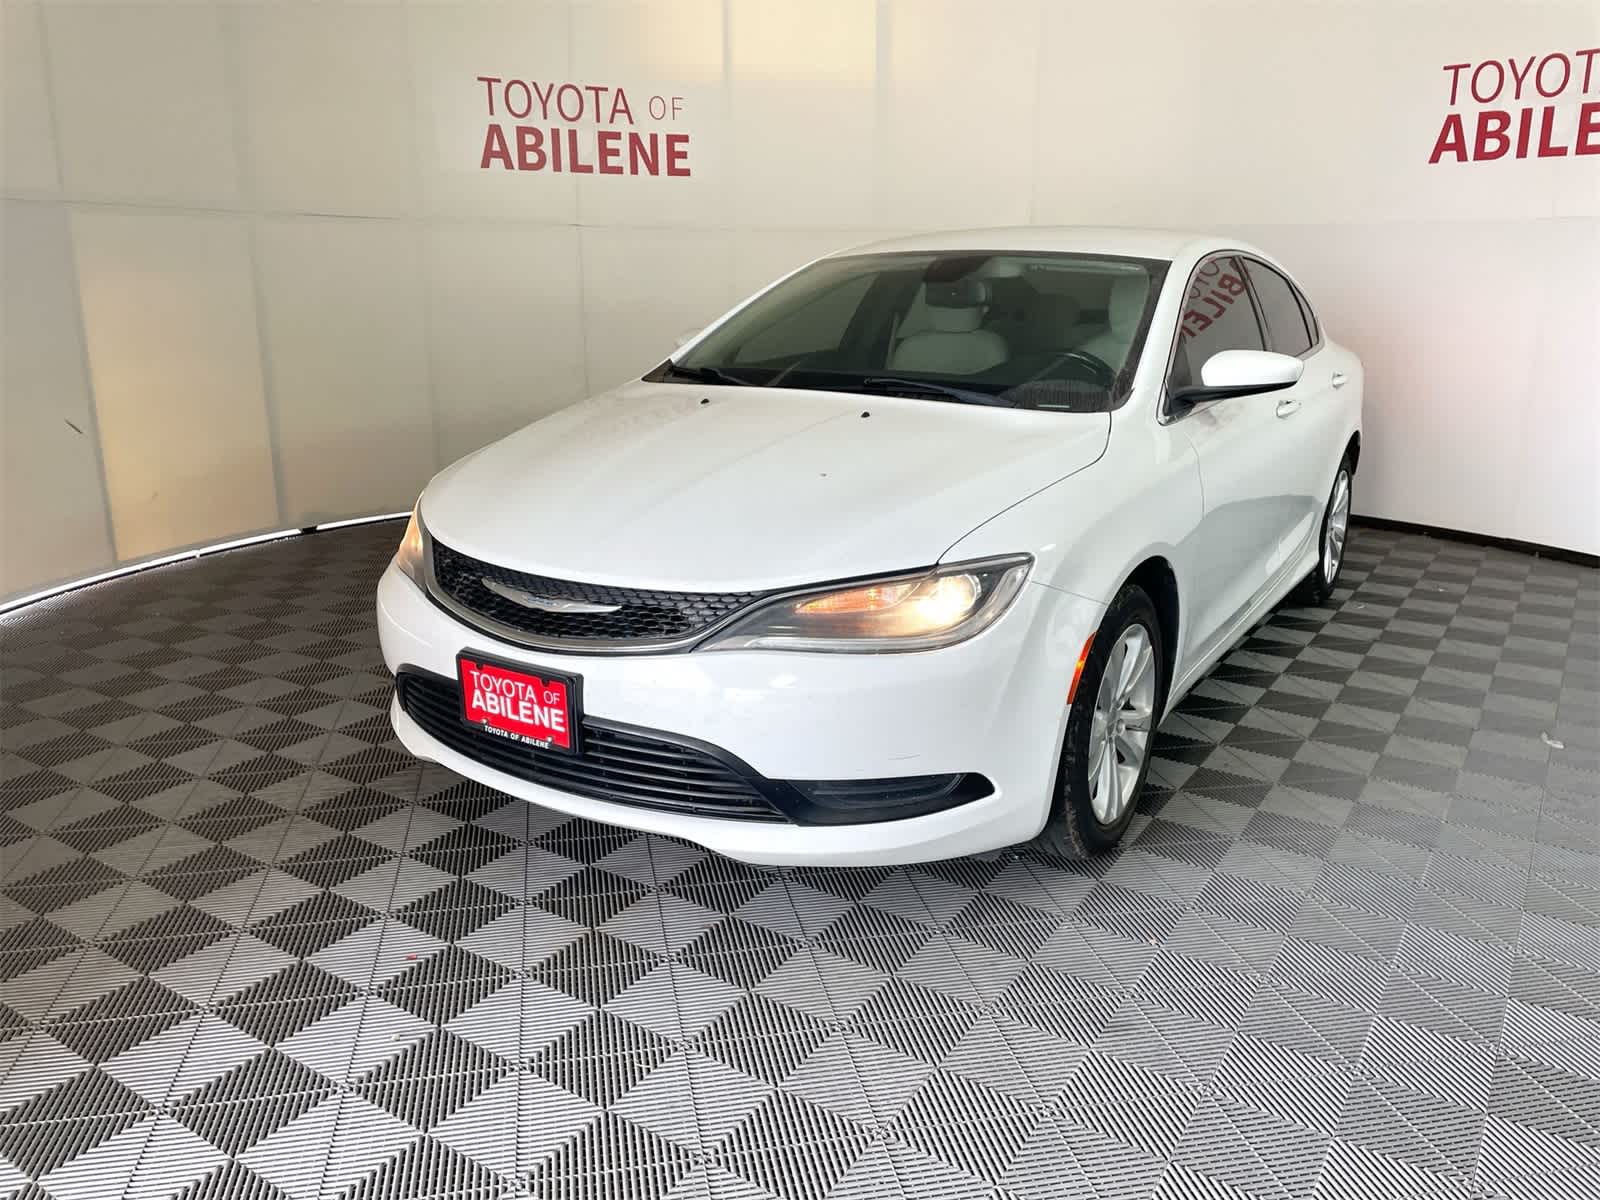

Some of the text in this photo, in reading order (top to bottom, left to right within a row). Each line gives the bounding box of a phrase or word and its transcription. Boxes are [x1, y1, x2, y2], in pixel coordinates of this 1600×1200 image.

[477, 77, 684, 125] TOYOTA OF
[480, 124, 691, 176] ABILENE
[469, 670, 560, 705] TOYOTA OF
[472, 689, 566, 732] ABILENE
[484, 725, 549, 749] TOYOTA OF ABILENE
